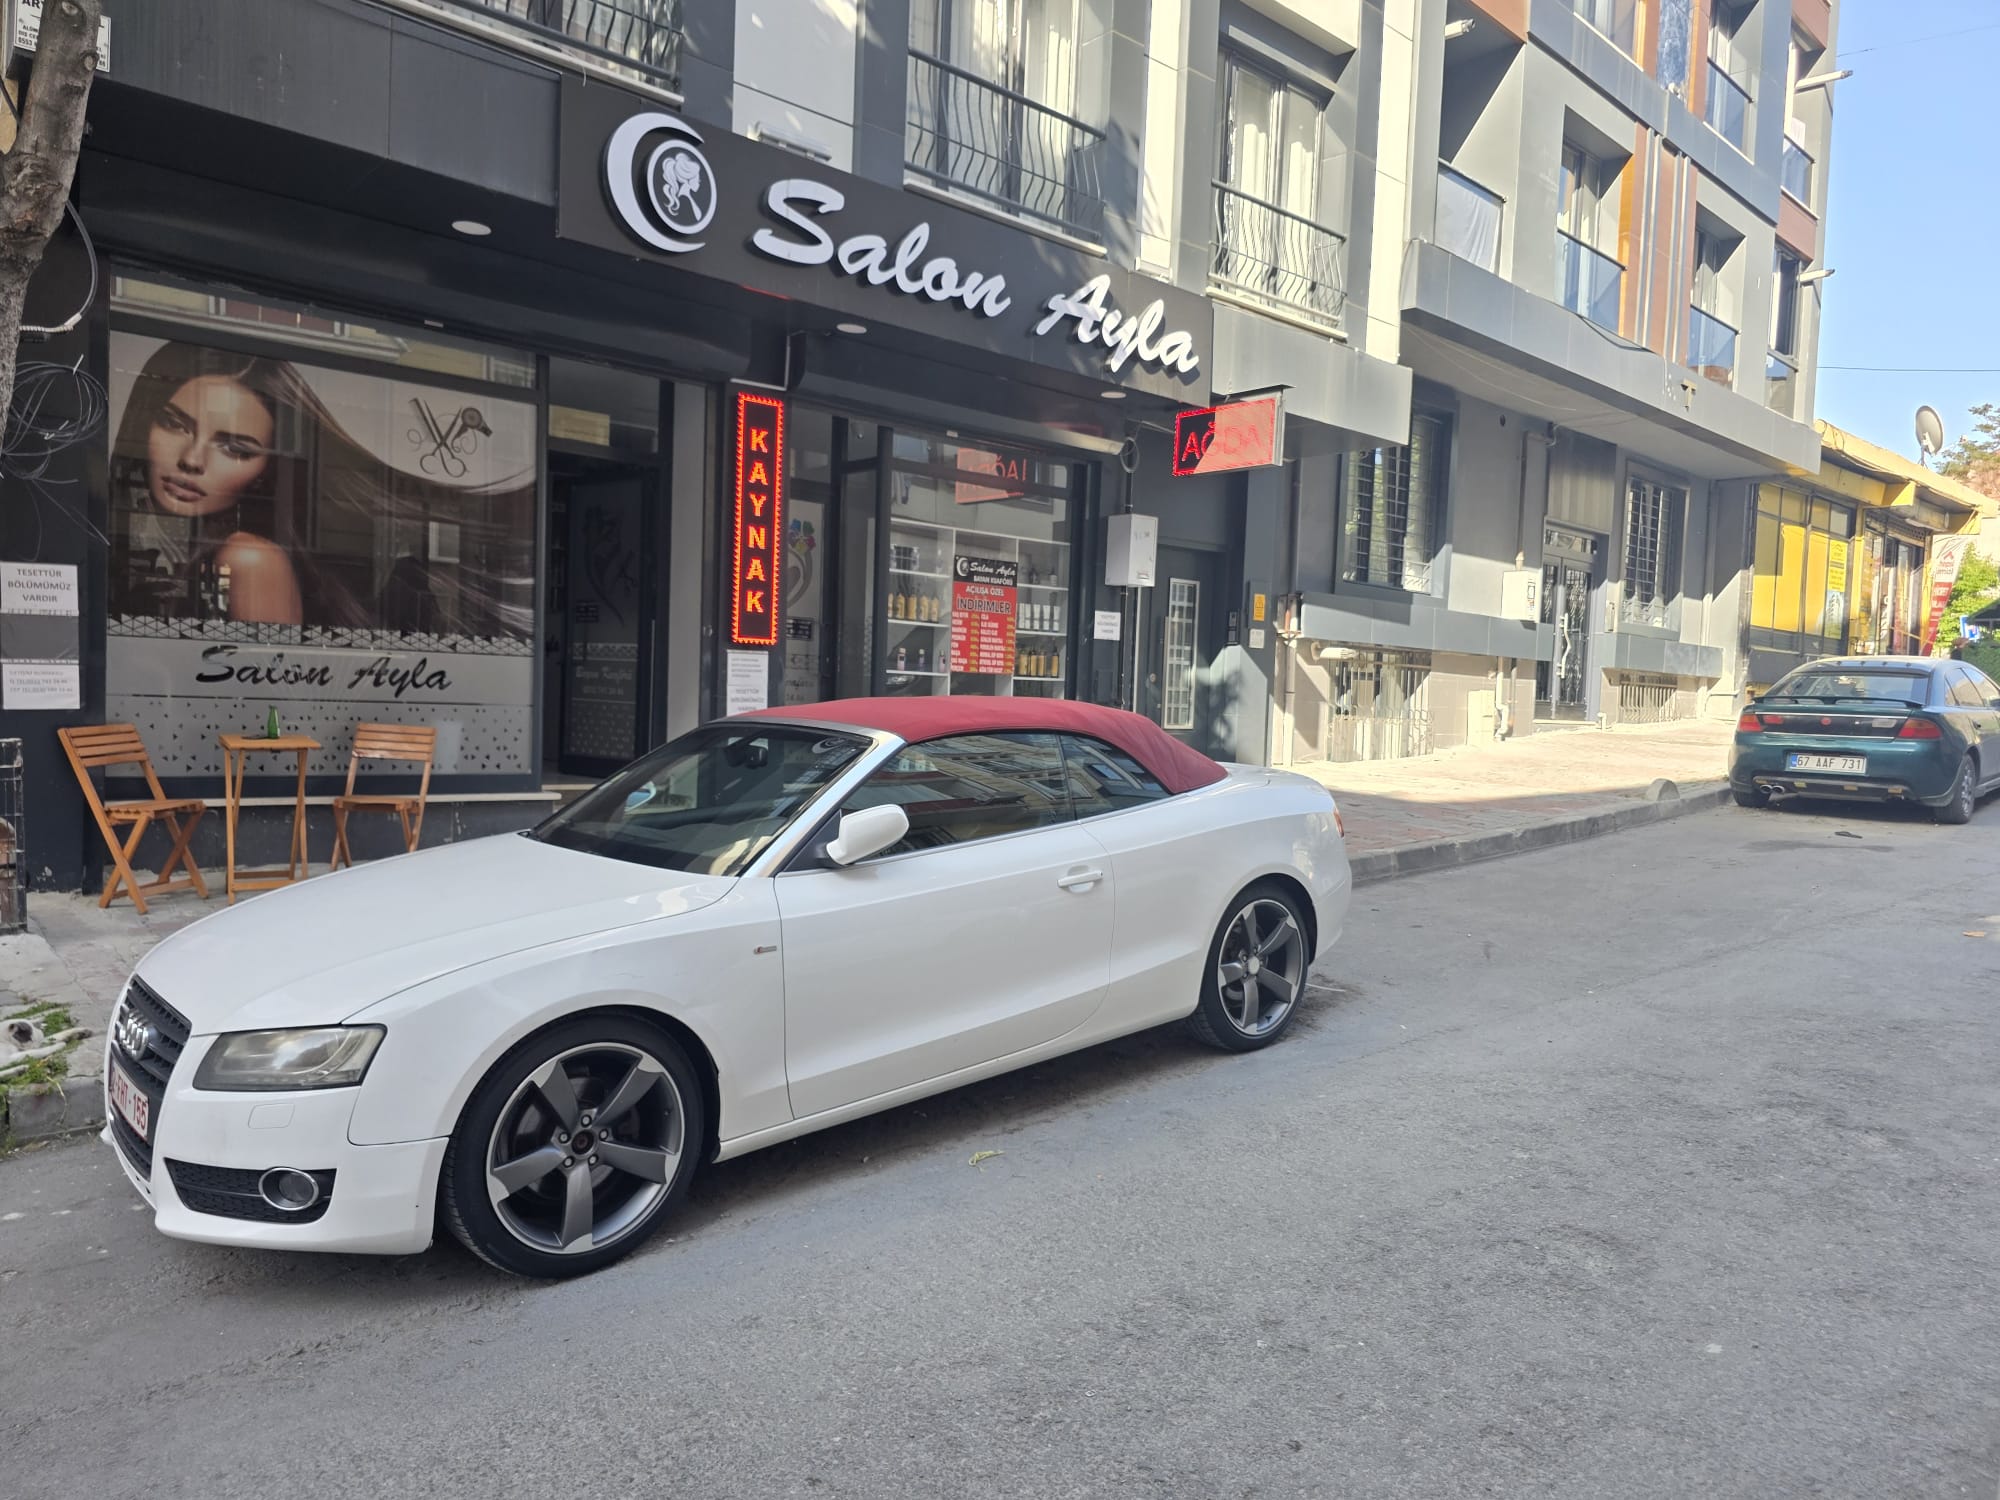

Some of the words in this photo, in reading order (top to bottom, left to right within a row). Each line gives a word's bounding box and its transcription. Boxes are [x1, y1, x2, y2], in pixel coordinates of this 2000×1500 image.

[753, 179, 1011, 318] Salon
[1036, 274, 1199, 373] Ayla
[1181, 421, 1262, 462] AĞDA
[745, 427, 769, 614] KAYNAK
[17, 567, 62, 578] TESETTÜR
[970, 562, 994, 573] Salon
[995, 565, 1016, 577] Ayla
[7, 580, 72, 592] BÖLÜMÜMÜZ
[22, 594, 58, 603] VARDIR
[956, 593, 1013, 614] İNDİRİMLER
[195, 645, 333, 686] Salon
[347, 653, 452, 699] Ayla
[1797, 757, 1810, 768] 67
[1815, 757, 1835, 769] AAF
[1841, 758, 1862, 770] 731
